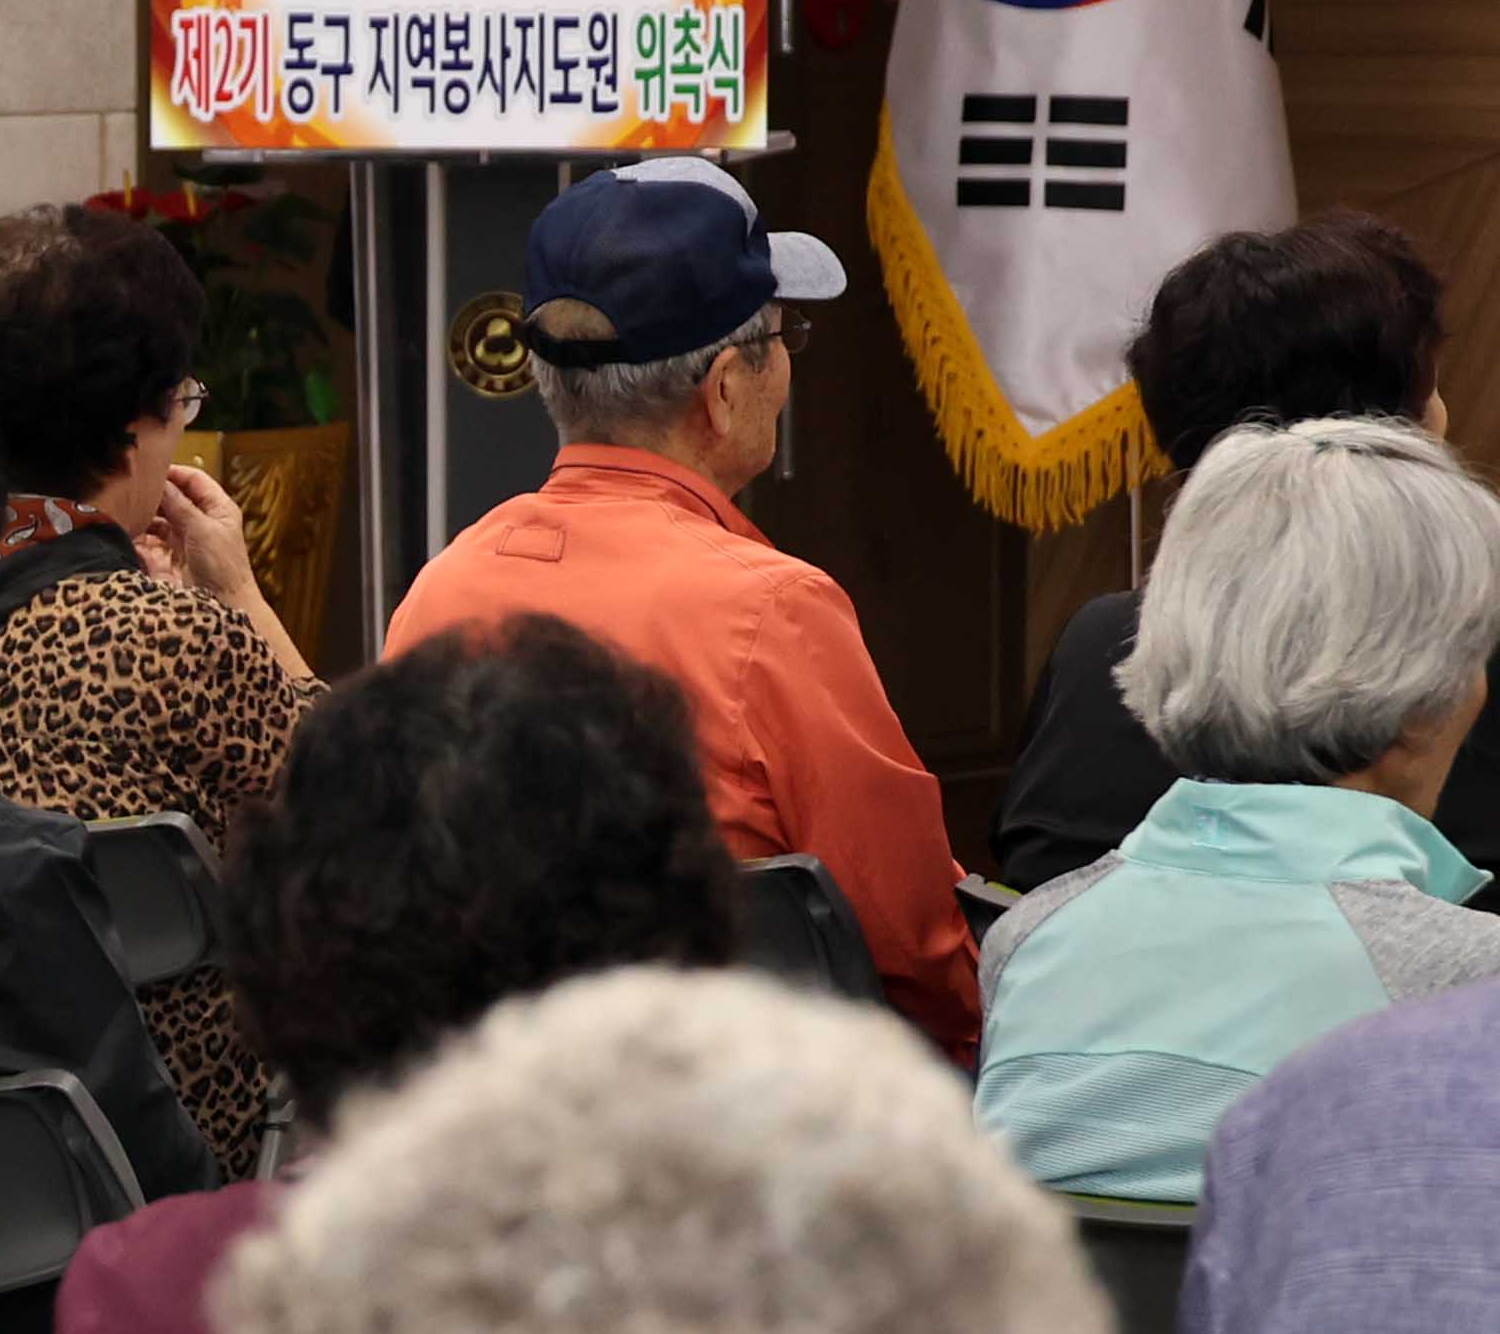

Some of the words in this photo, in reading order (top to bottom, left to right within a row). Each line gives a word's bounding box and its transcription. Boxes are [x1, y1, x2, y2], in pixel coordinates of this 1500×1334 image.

[177, 12, 269, 114] 제2기
[283, 13, 354, 114] 동구
[367, 11, 620, 114] 지역봉사지도원
[634, 9, 740, 114] 위촉식
